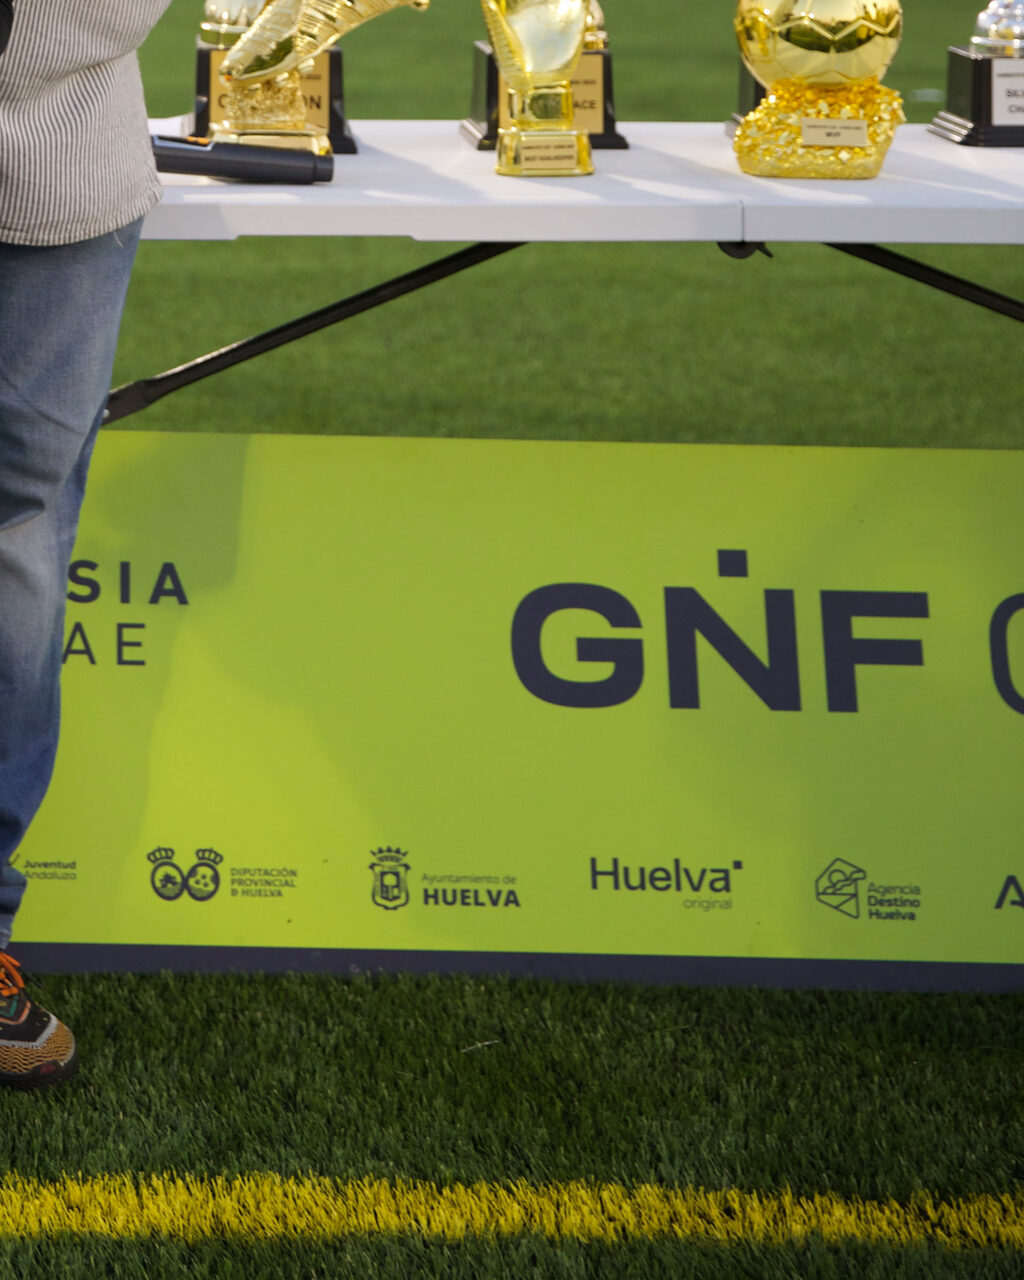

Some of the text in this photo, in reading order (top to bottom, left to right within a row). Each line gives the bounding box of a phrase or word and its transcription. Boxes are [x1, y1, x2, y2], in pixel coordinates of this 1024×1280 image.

[23, 860, 76, 869] Juventud
[230, 866, 297, 877] DIPUTACIÓN
[589, 856, 732, 893] Huelva
[230, 878, 296, 887] PROVINCIAL
[422, 873, 517, 885] Ayuntamiento de
[241, 888, 283, 898] HUELVA
[867, 883, 921, 896] Agencia
[422, 887, 521, 907] HUELVA
[867, 895, 921, 908] Destino
[683, 896, 733, 912] original
[867, 908, 916, 920] Huelva
